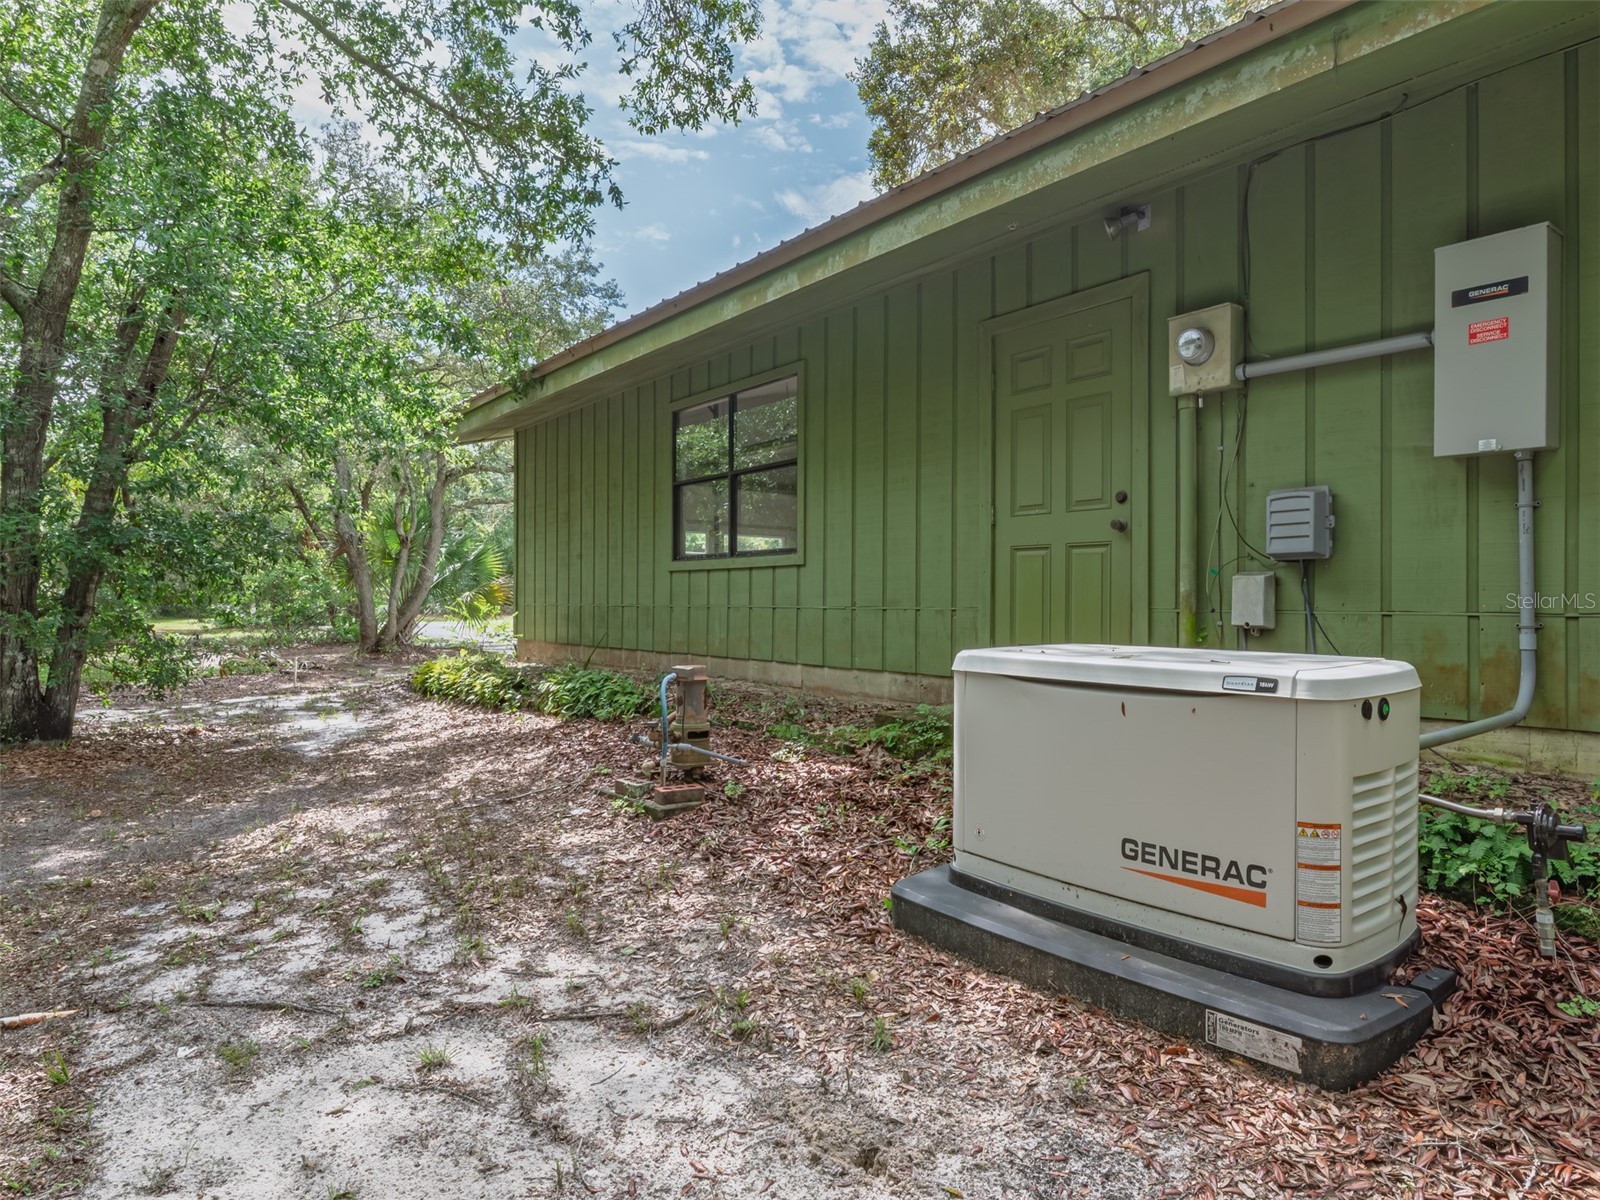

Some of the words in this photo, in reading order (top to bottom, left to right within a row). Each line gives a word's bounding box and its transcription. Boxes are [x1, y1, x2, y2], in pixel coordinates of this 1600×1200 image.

[1468, 284, 1509, 298] GENERAC
[1470, 318, 1507, 328] EMERGENCY
[1470, 322, 1507, 334] DISCONNECT
[1470, 332, 1507, 344] DISCONNECT
[1476, 329, 1501, 339] SERVICE
[1120, 837, 1268, 889] GENERAC
[1218, 1017, 1260, 1035] Generators
[1229, 1027, 1243, 1036] MPH
